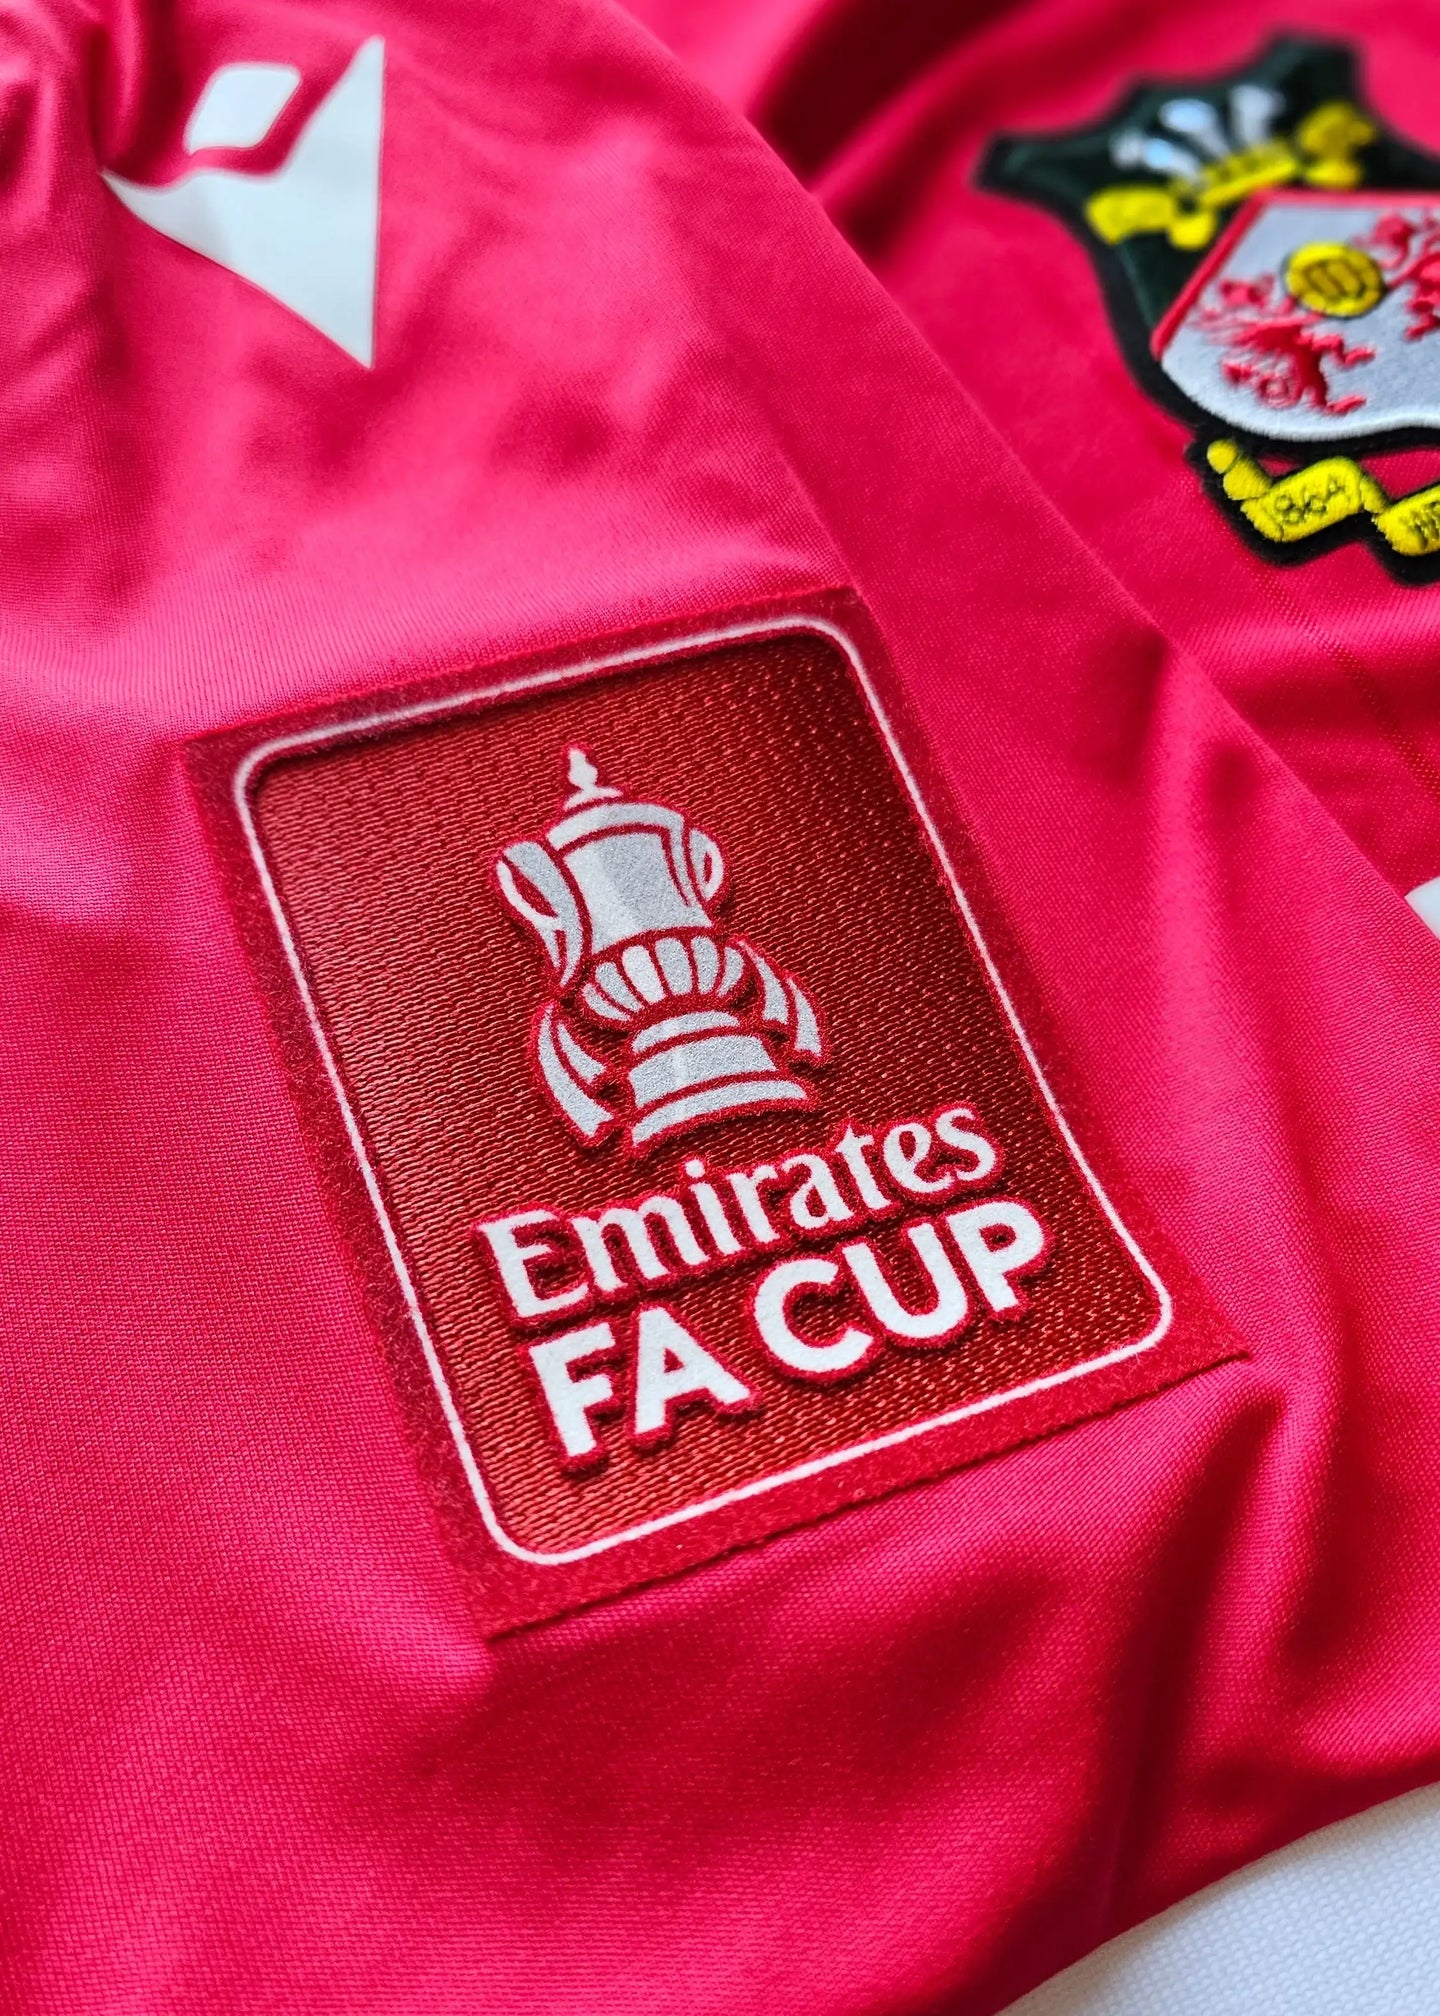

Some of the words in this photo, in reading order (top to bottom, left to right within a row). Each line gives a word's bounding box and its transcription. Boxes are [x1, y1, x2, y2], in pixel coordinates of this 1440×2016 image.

[478, 1107, 998, 1319] Emirates
[528, 1306, 751, 1458] FA
[752, 1200, 1046, 1374] CUP
